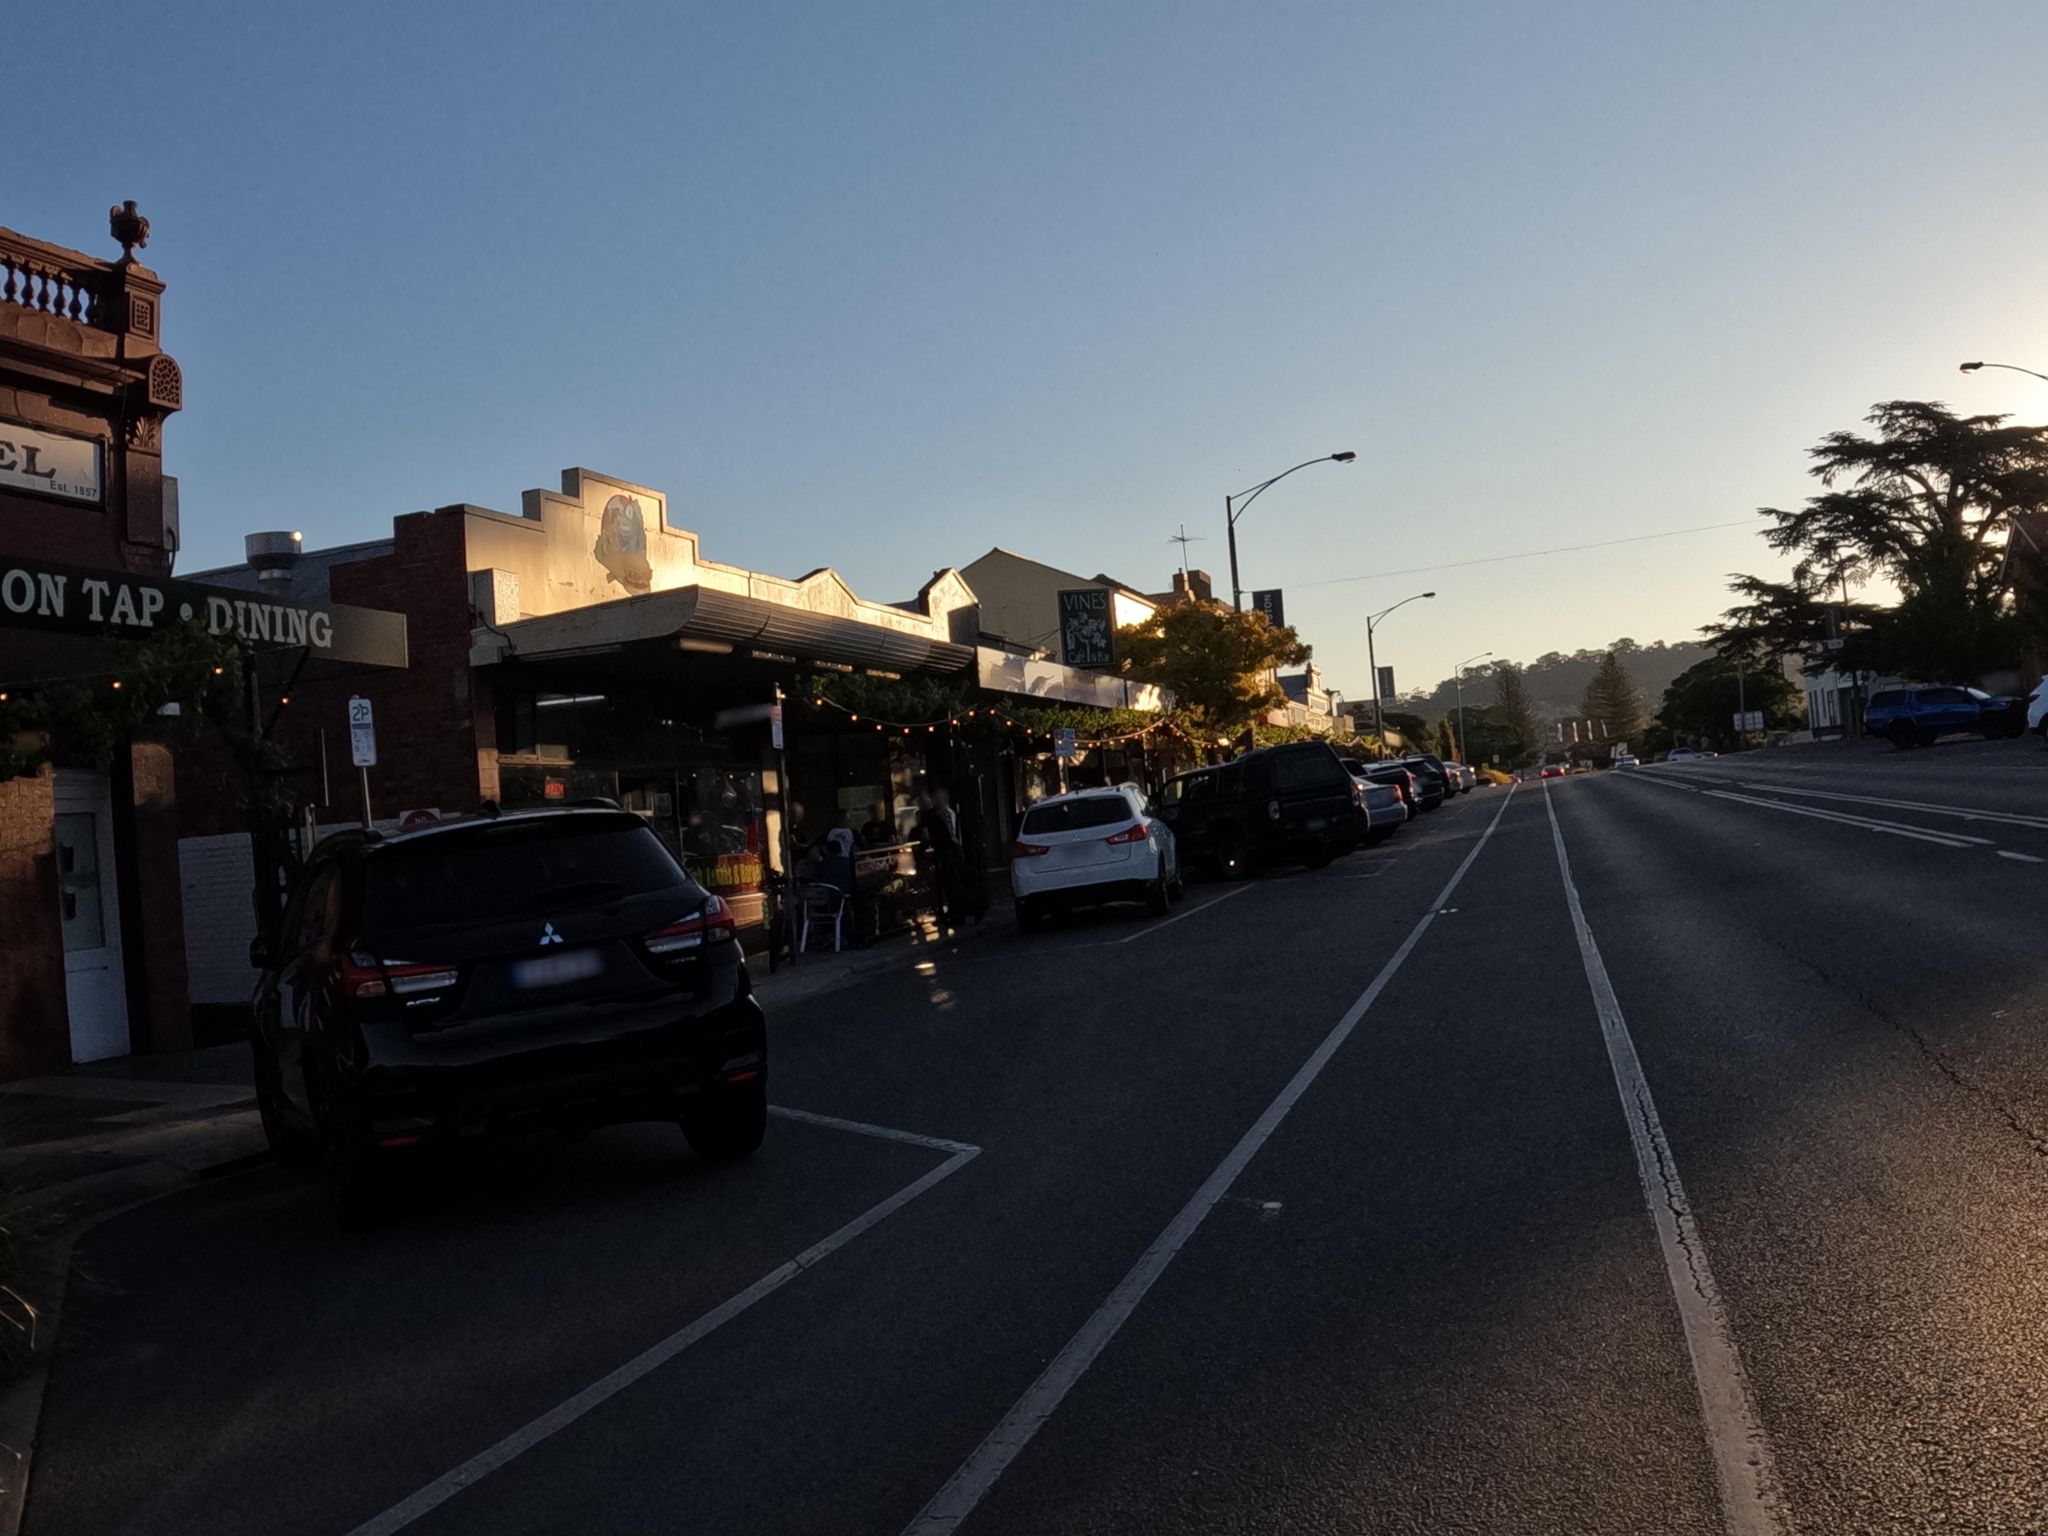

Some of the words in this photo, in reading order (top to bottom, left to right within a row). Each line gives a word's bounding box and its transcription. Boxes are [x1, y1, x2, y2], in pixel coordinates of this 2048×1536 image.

[50, 479, 69, 494] Est.
[74, 485, 97, 497] 1857
[1, 568, 67, 617] ON
[82, 578, 165, 628] TAP
[206, 597, 334, 649] DINING
[1063, 592, 1106, 611] VINES
